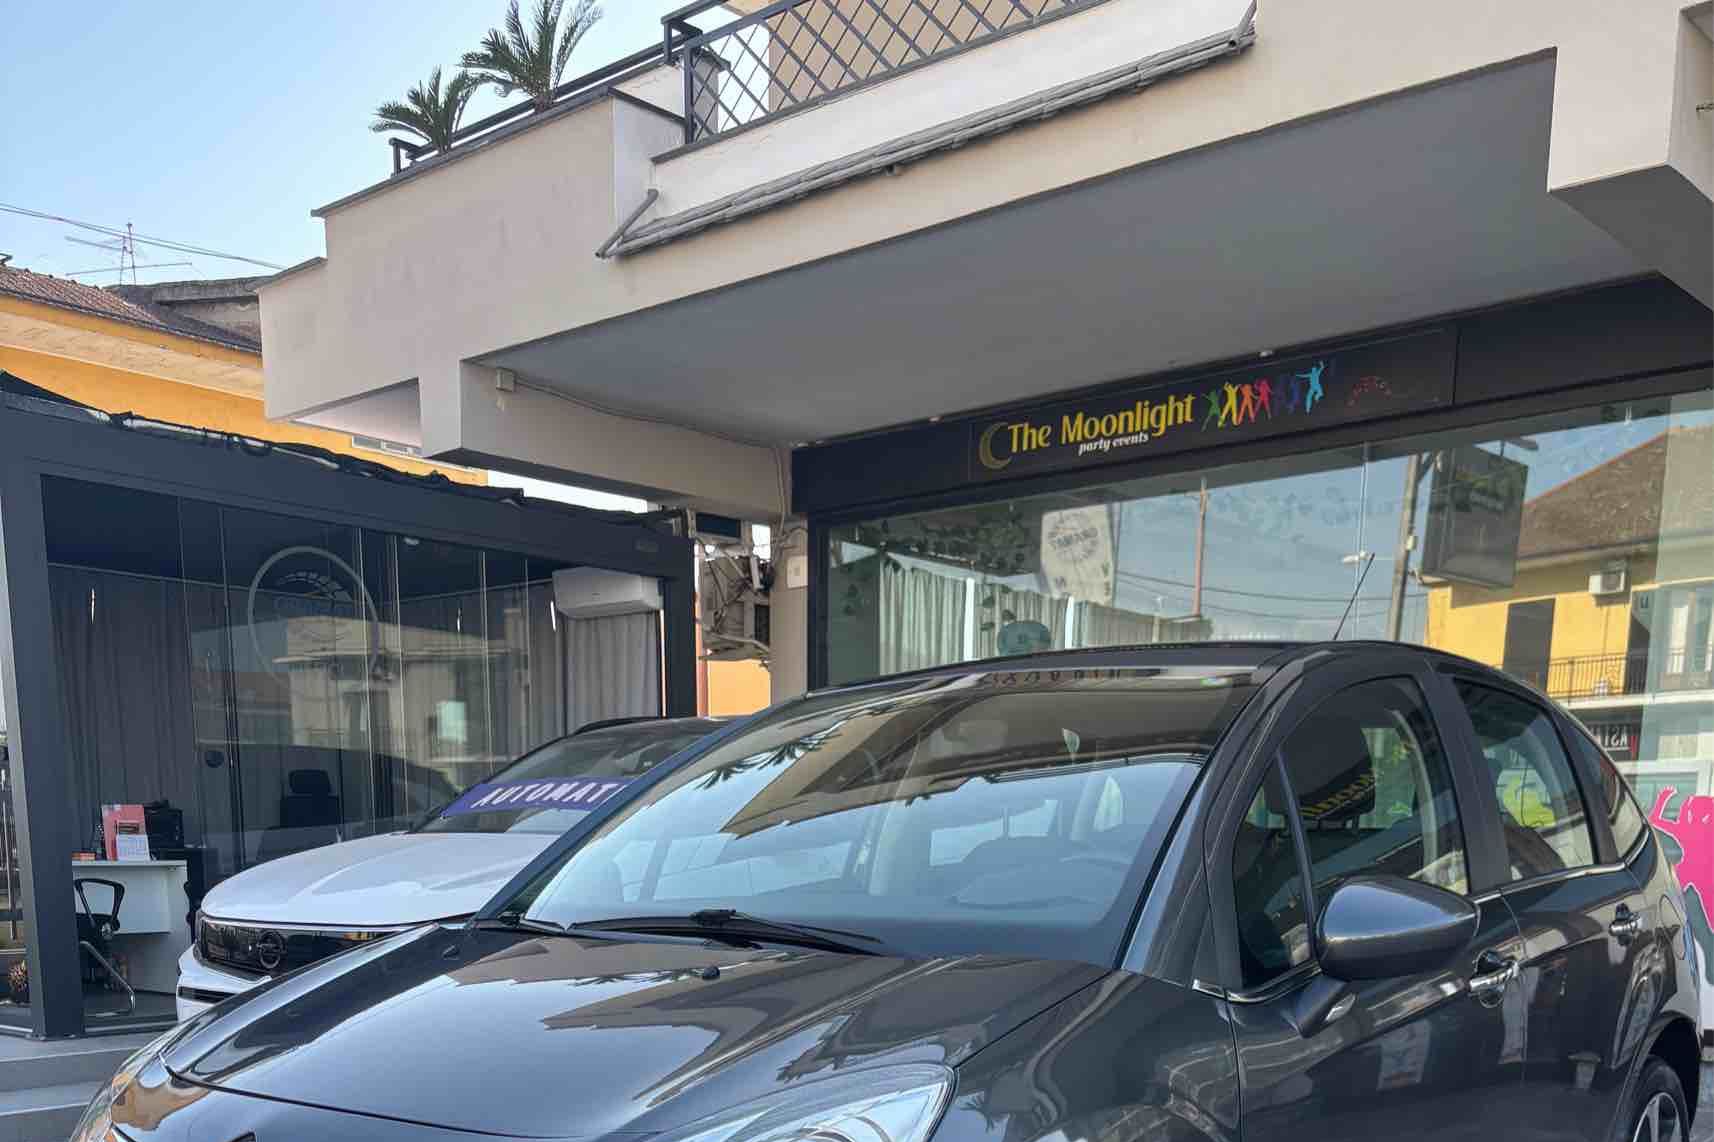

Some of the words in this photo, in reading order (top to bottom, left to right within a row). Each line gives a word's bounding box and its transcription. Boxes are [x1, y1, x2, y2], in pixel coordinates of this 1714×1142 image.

[1008, 422, 1051, 453] The
[1062, 394, 1195, 445] Moonlight
[1078, 436, 1111, 456] party
[1113, 431, 1149, 448] events
